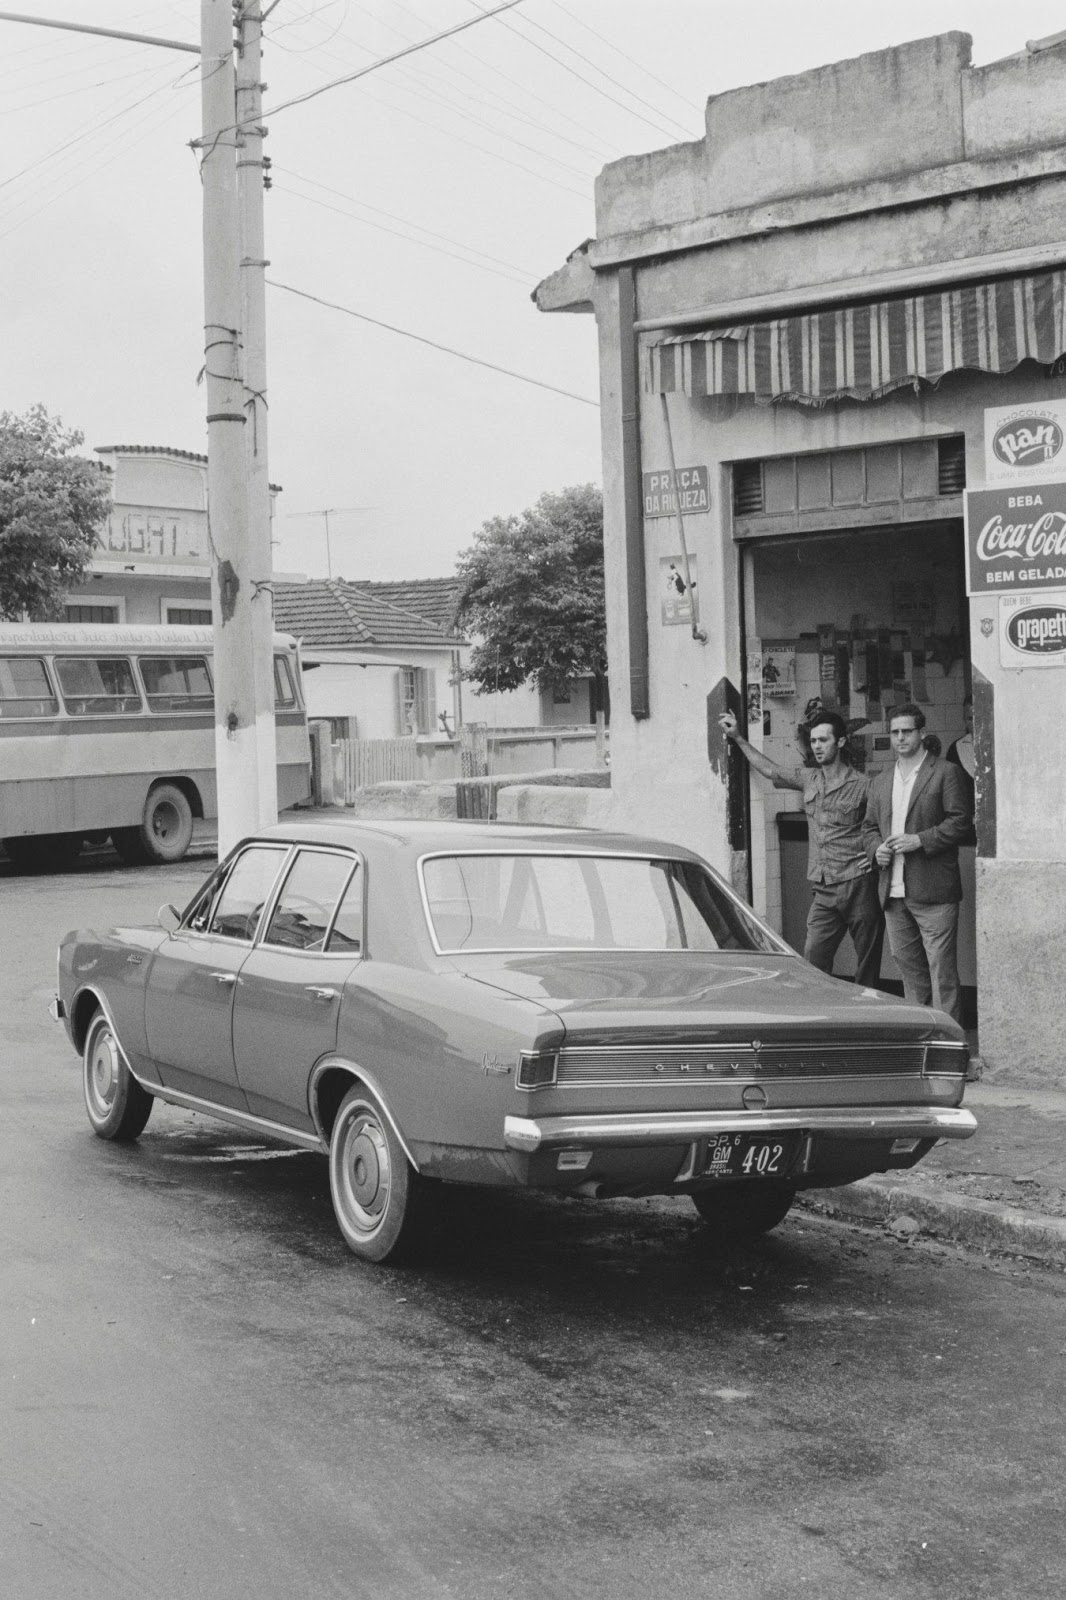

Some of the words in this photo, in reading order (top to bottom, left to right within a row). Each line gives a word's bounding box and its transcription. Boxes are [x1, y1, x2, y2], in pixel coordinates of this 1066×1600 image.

[997, 410, 1059, 427] CHOCOLATE
[998, 425, 1055, 465] pan
[645, 495, 660, 513] DA
[1008, 494, 1043, 508] BEBA
[976, 511, 1066, 561] Coca-Col
[986, 570, 1015, 583] BEM
[1018, 567, 1066, 581] GELAD
[655, 1060, 847, 1071] CHEVROLET
[734, 1135, 742, 1146] 6
[713, 1146, 732, 1161] GM
[742, 1145, 783, 1173] 4-02
